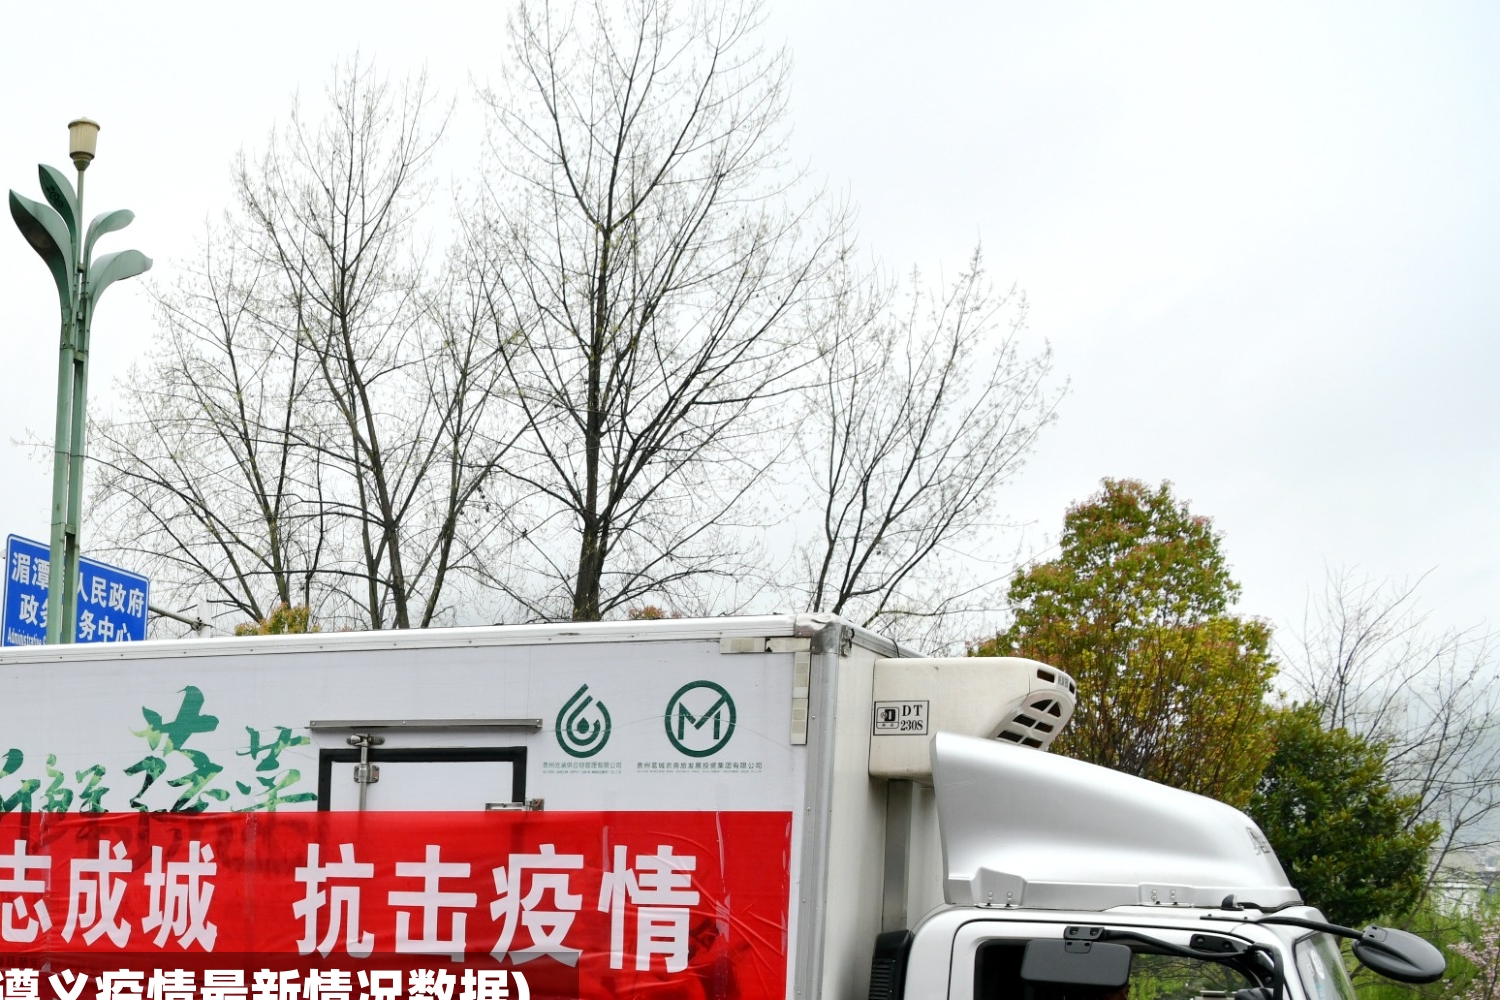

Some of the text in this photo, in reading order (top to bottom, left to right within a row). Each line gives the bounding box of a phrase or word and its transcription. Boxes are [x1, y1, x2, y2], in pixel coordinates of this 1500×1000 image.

[11, 552, 145, 618] 湄潭人民政府
[19, 593, 132, 643] 政务中心
[900, 720, 923, 731] 230S
[293, 842, 700, 974] 抗击疫情
